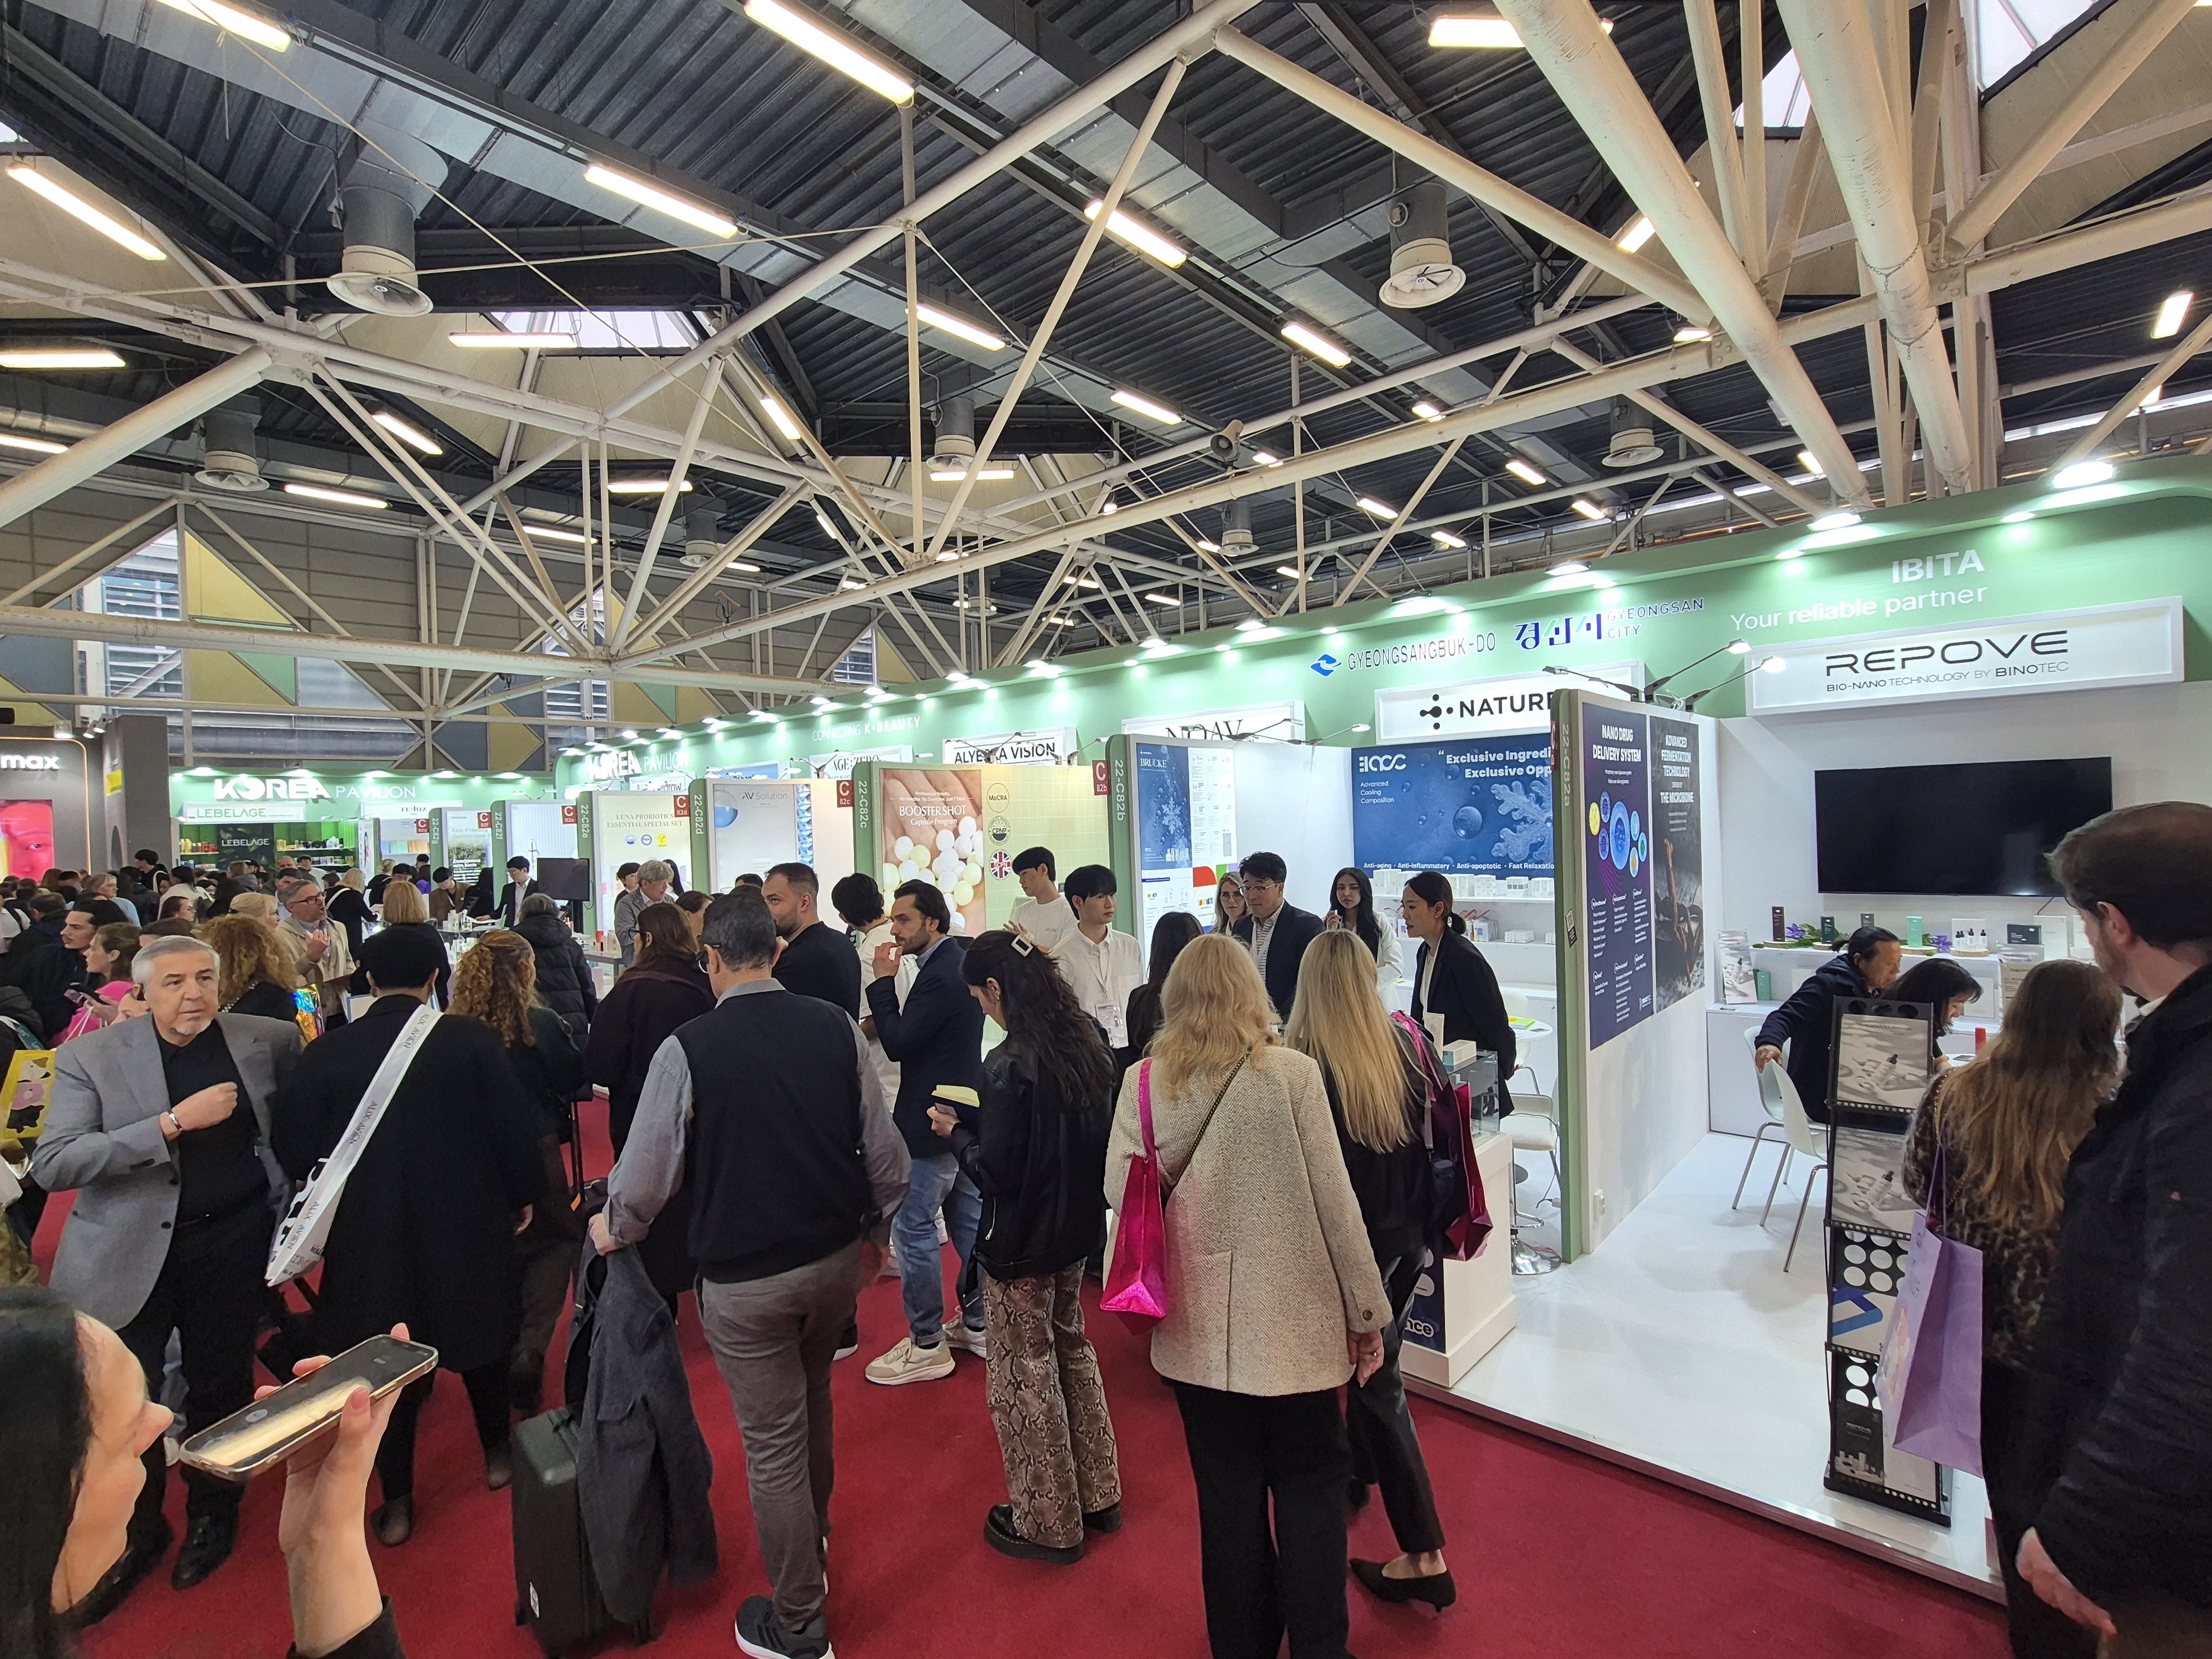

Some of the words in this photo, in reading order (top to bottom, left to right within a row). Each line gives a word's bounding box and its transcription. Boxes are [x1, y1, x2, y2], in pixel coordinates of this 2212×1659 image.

[1892, 549, 1985, 584] IBITA
[1607, 598, 1704, 622] GYEONGSAN
[1730, 612, 1782, 631] Your
[1788, 598, 1877, 624] reliable
[1885, 586, 1988, 618] partner
[1514, 613, 1602, 650] 경산시
[1608, 624, 1641, 639] CITY
[1825, 630, 2068, 676] REPOVE
[1888, 671, 1970, 686] TECHNOLOGY
[1975, 669, 1991, 679] BY
[1995, 661, 2070, 677] BINOTEC
[812, 724, 861, 742] CONNECTING
[1602, 724, 1618, 740] NANO
[1619, 727, 1634, 742] DRUG
[1665, 734, 1687, 748] ADVANCED
[0, 755, 60, 769] max
[954, 747, 1008, 764] ALYEA
[1011, 743, 1055, 759] VISION
[1446, 750, 1505, 764] Exclusive
[1593, 744, 1620, 761] DELIVERY
[1620, 748, 1641, 762] SYSTEM
[588, 749, 642, 780] KOREA
[644, 751, 690, 773] PAVILION
[1095, 762, 1105, 781] C
[1465, 765, 1524, 779] Exclusive
[1562, 723, 1571, 807] 22-C82a
[1663, 765, 1691, 778] TECHNOLOGY
[214, 778, 332, 800] KOREA
[335, 786, 416, 799] PAVILION
[755, 792, 788, 800] Solution
[839, 781, 849, 796] C
[1115, 759, 1125, 822] 22-C82b
[676, 796, 686, 808] C
[858, 780, 868, 828] 22-C82c
[1660, 792, 1670, 804] THE
[197, 808, 267, 818] LEBELAGE
[479, 812, 488, 822] C
[564, 806, 573, 816] C
[694, 795, 703, 834] 22-C82d
[899, 806, 941, 816] BOOSTER
[942, 805, 967, 816] SHOT
[910, 818, 933, 827] Capsule
[935, 818, 958, 826] Program
[221, 838, 270, 847] LEBELAGE
